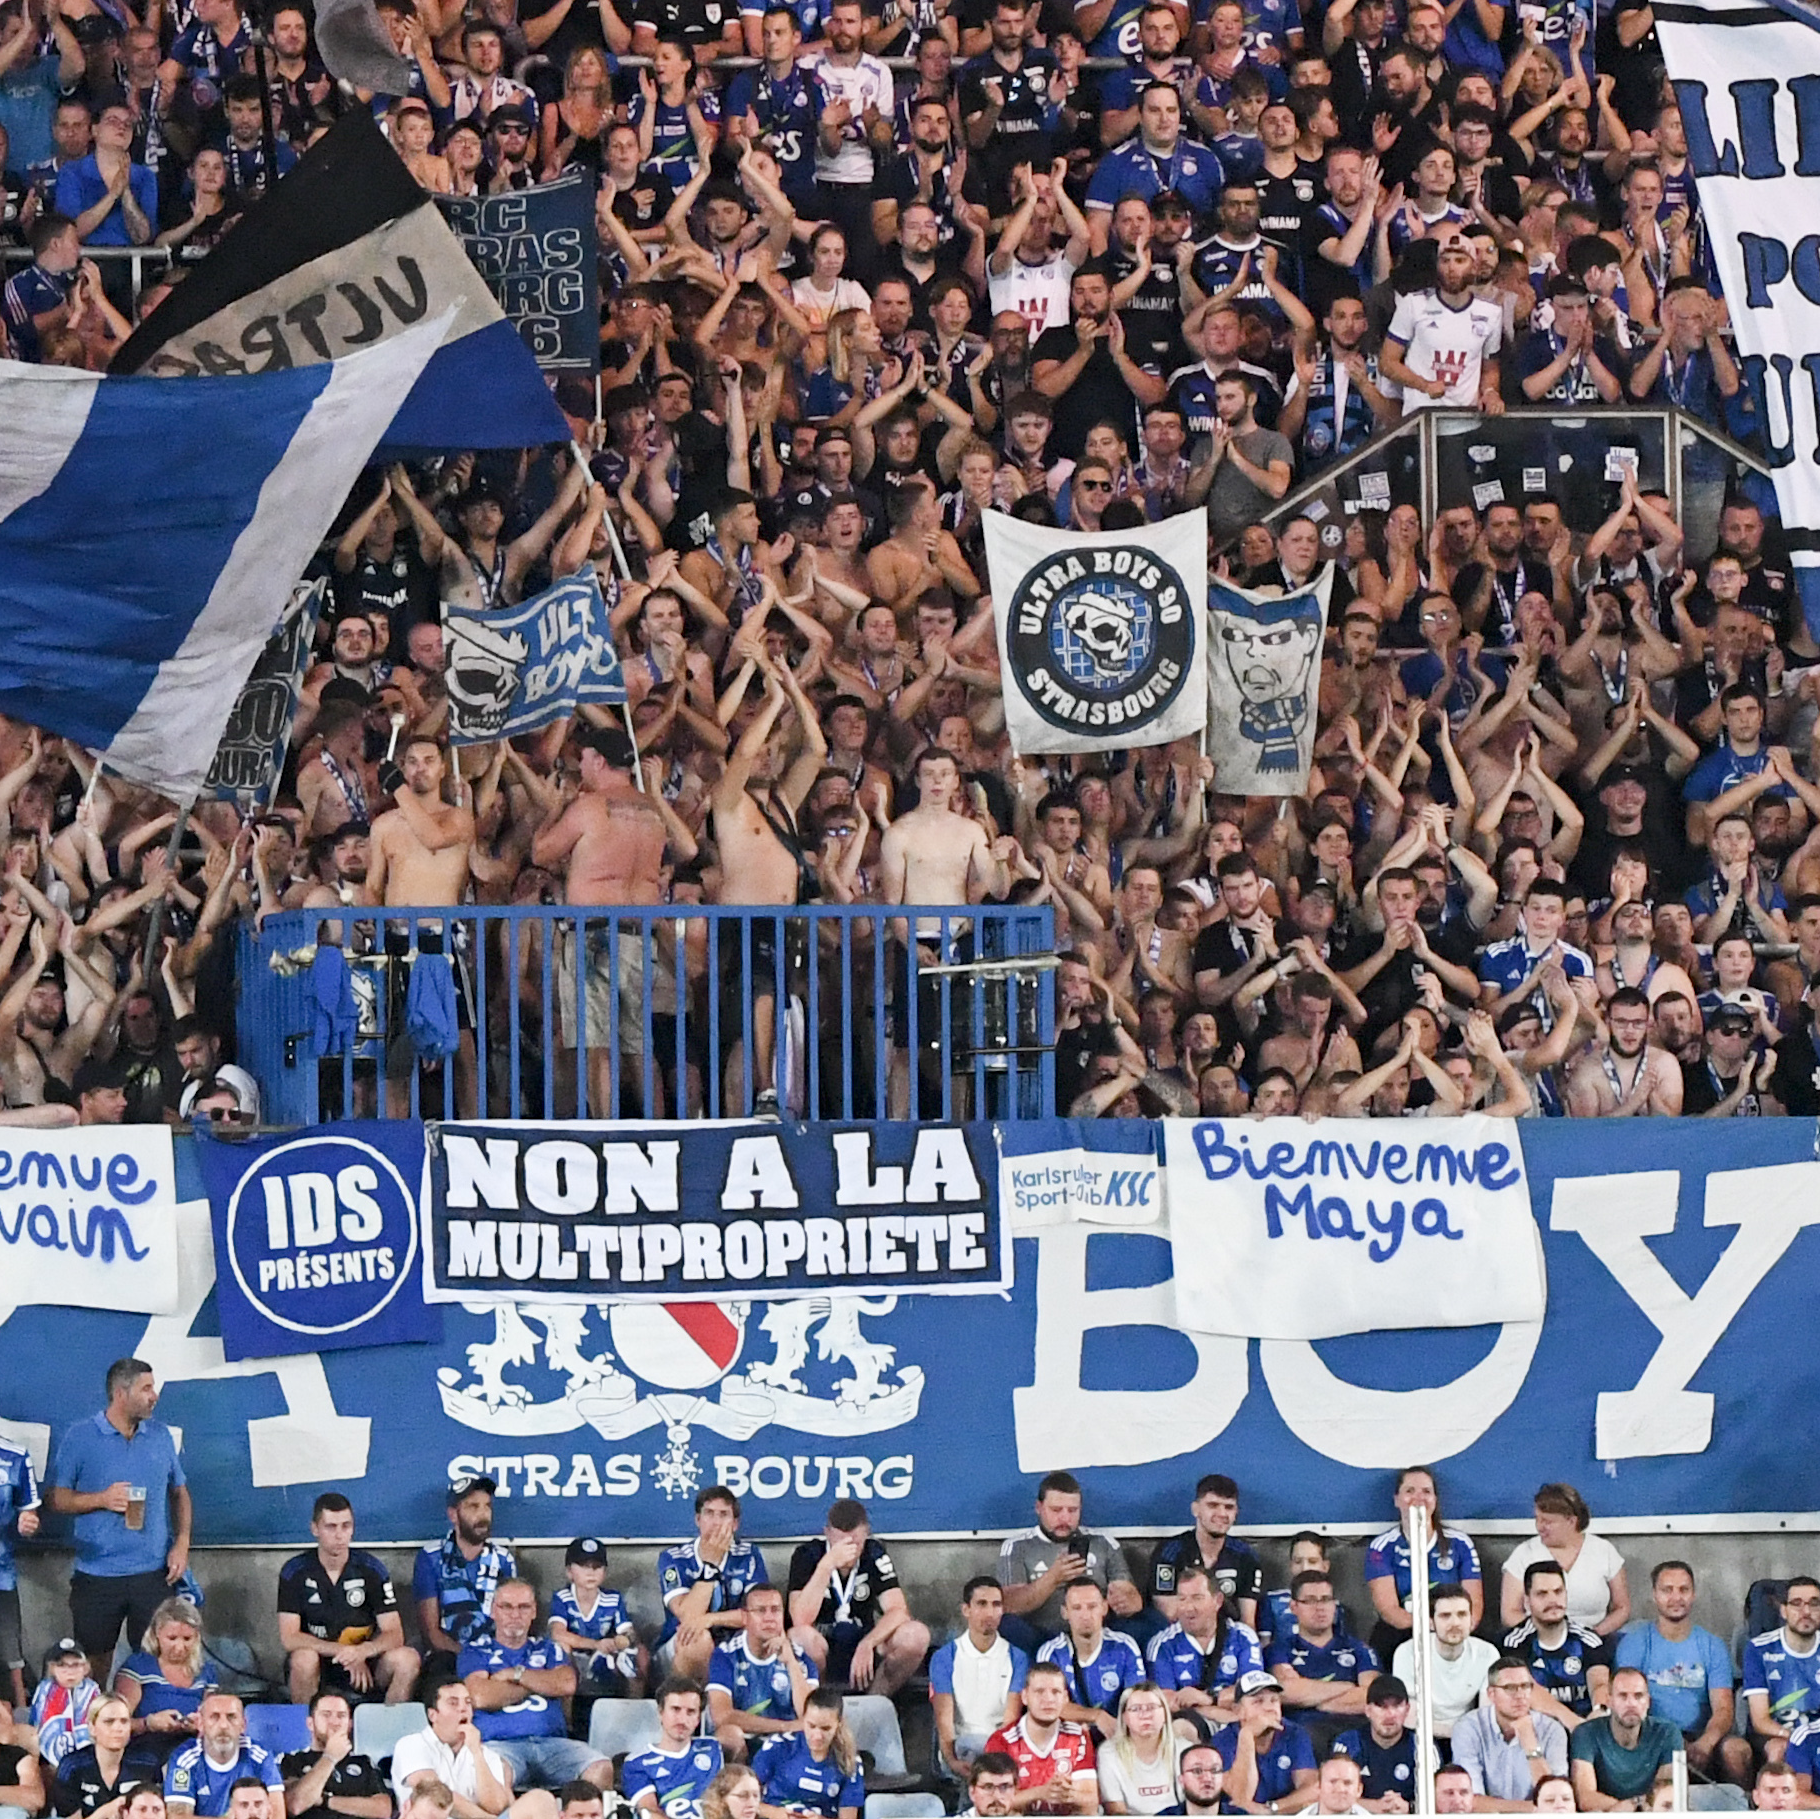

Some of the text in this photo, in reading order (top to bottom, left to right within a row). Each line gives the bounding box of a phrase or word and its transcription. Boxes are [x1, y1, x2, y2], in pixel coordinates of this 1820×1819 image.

[464, 228, 584, 277] RAS
[1019, 550, 1183, 636] ULTRA BOYS 90
[1026, 656, 1181, 727] STRASBOURG
[442, 1127, 982, 1216] NON A LA
[1103, 1170, 1157, 1207] KSC
[262, 1164, 384, 1252] IDS
[1263, 1184, 1465, 1264] Maya
[259, 1247, 397, 1293] PRÉSENTS
[447, 1211, 987, 1282] MULTIPROPRIETE
